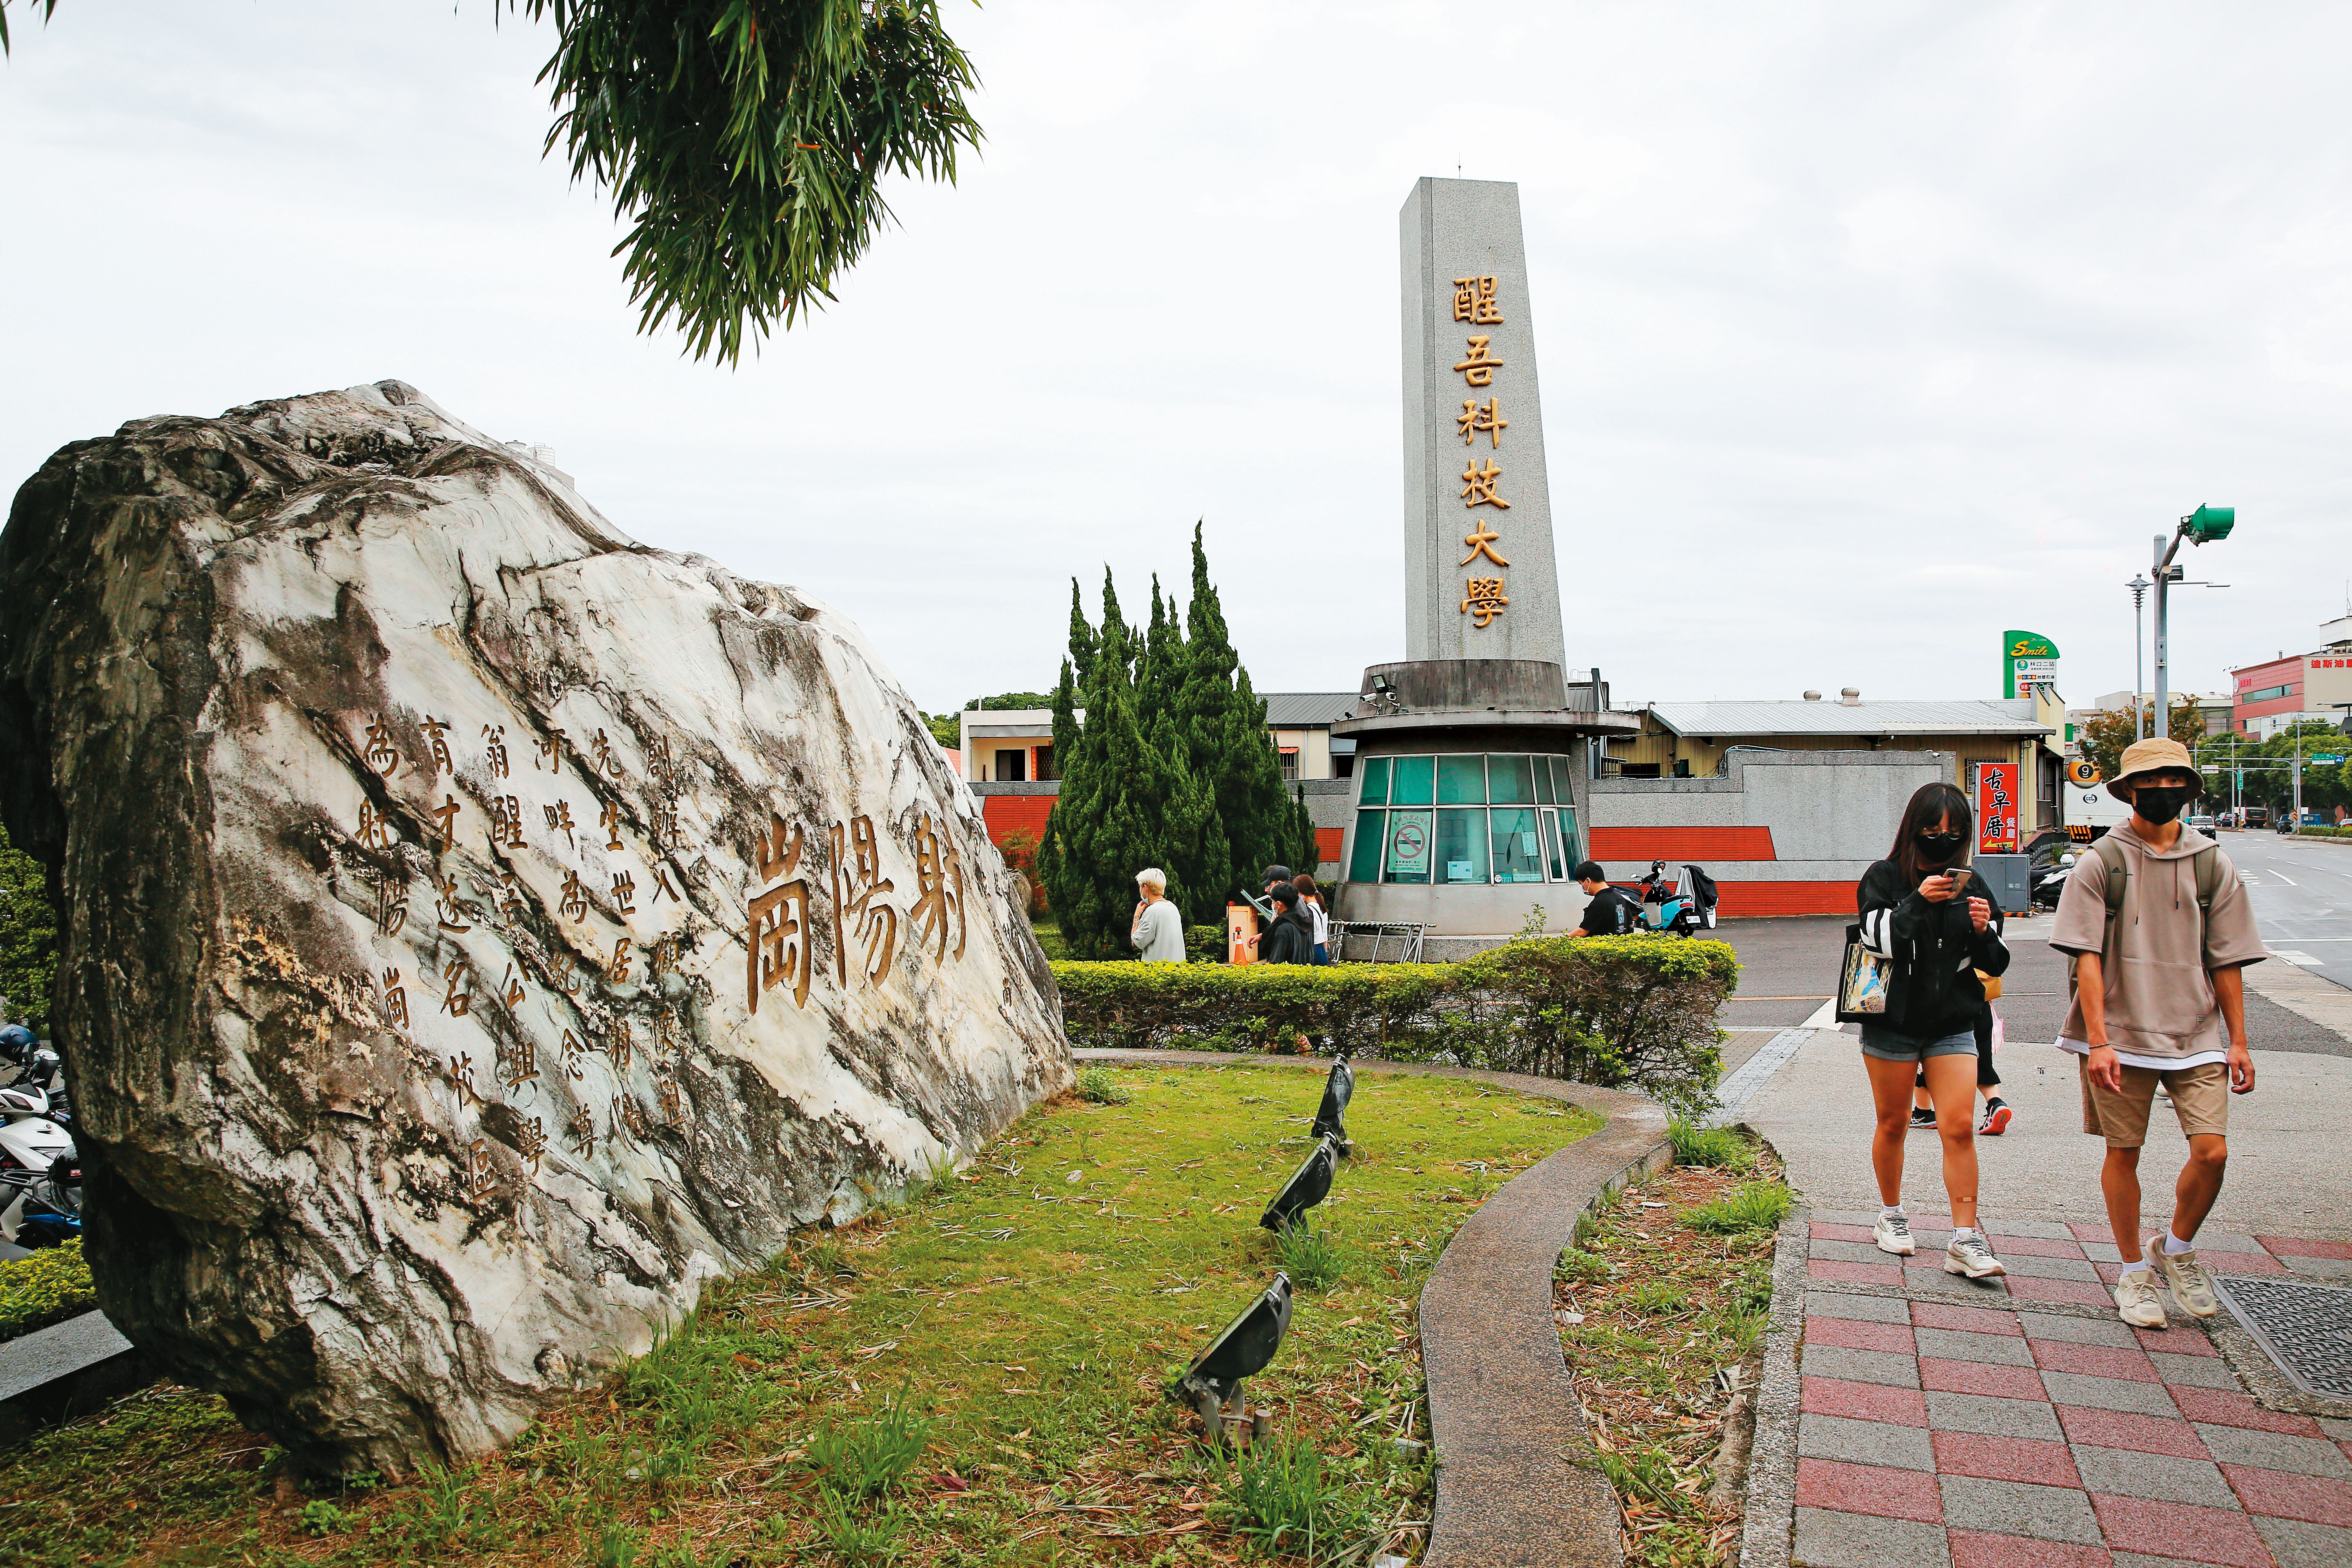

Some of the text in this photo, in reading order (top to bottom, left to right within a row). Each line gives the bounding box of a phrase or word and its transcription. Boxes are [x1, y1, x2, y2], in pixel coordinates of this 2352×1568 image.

[1453, 276, 1511, 628] 醒吾科技大學
[2010, 641, 2047, 656] Smile
[2006, 817, 2016, 838] 餐廳
